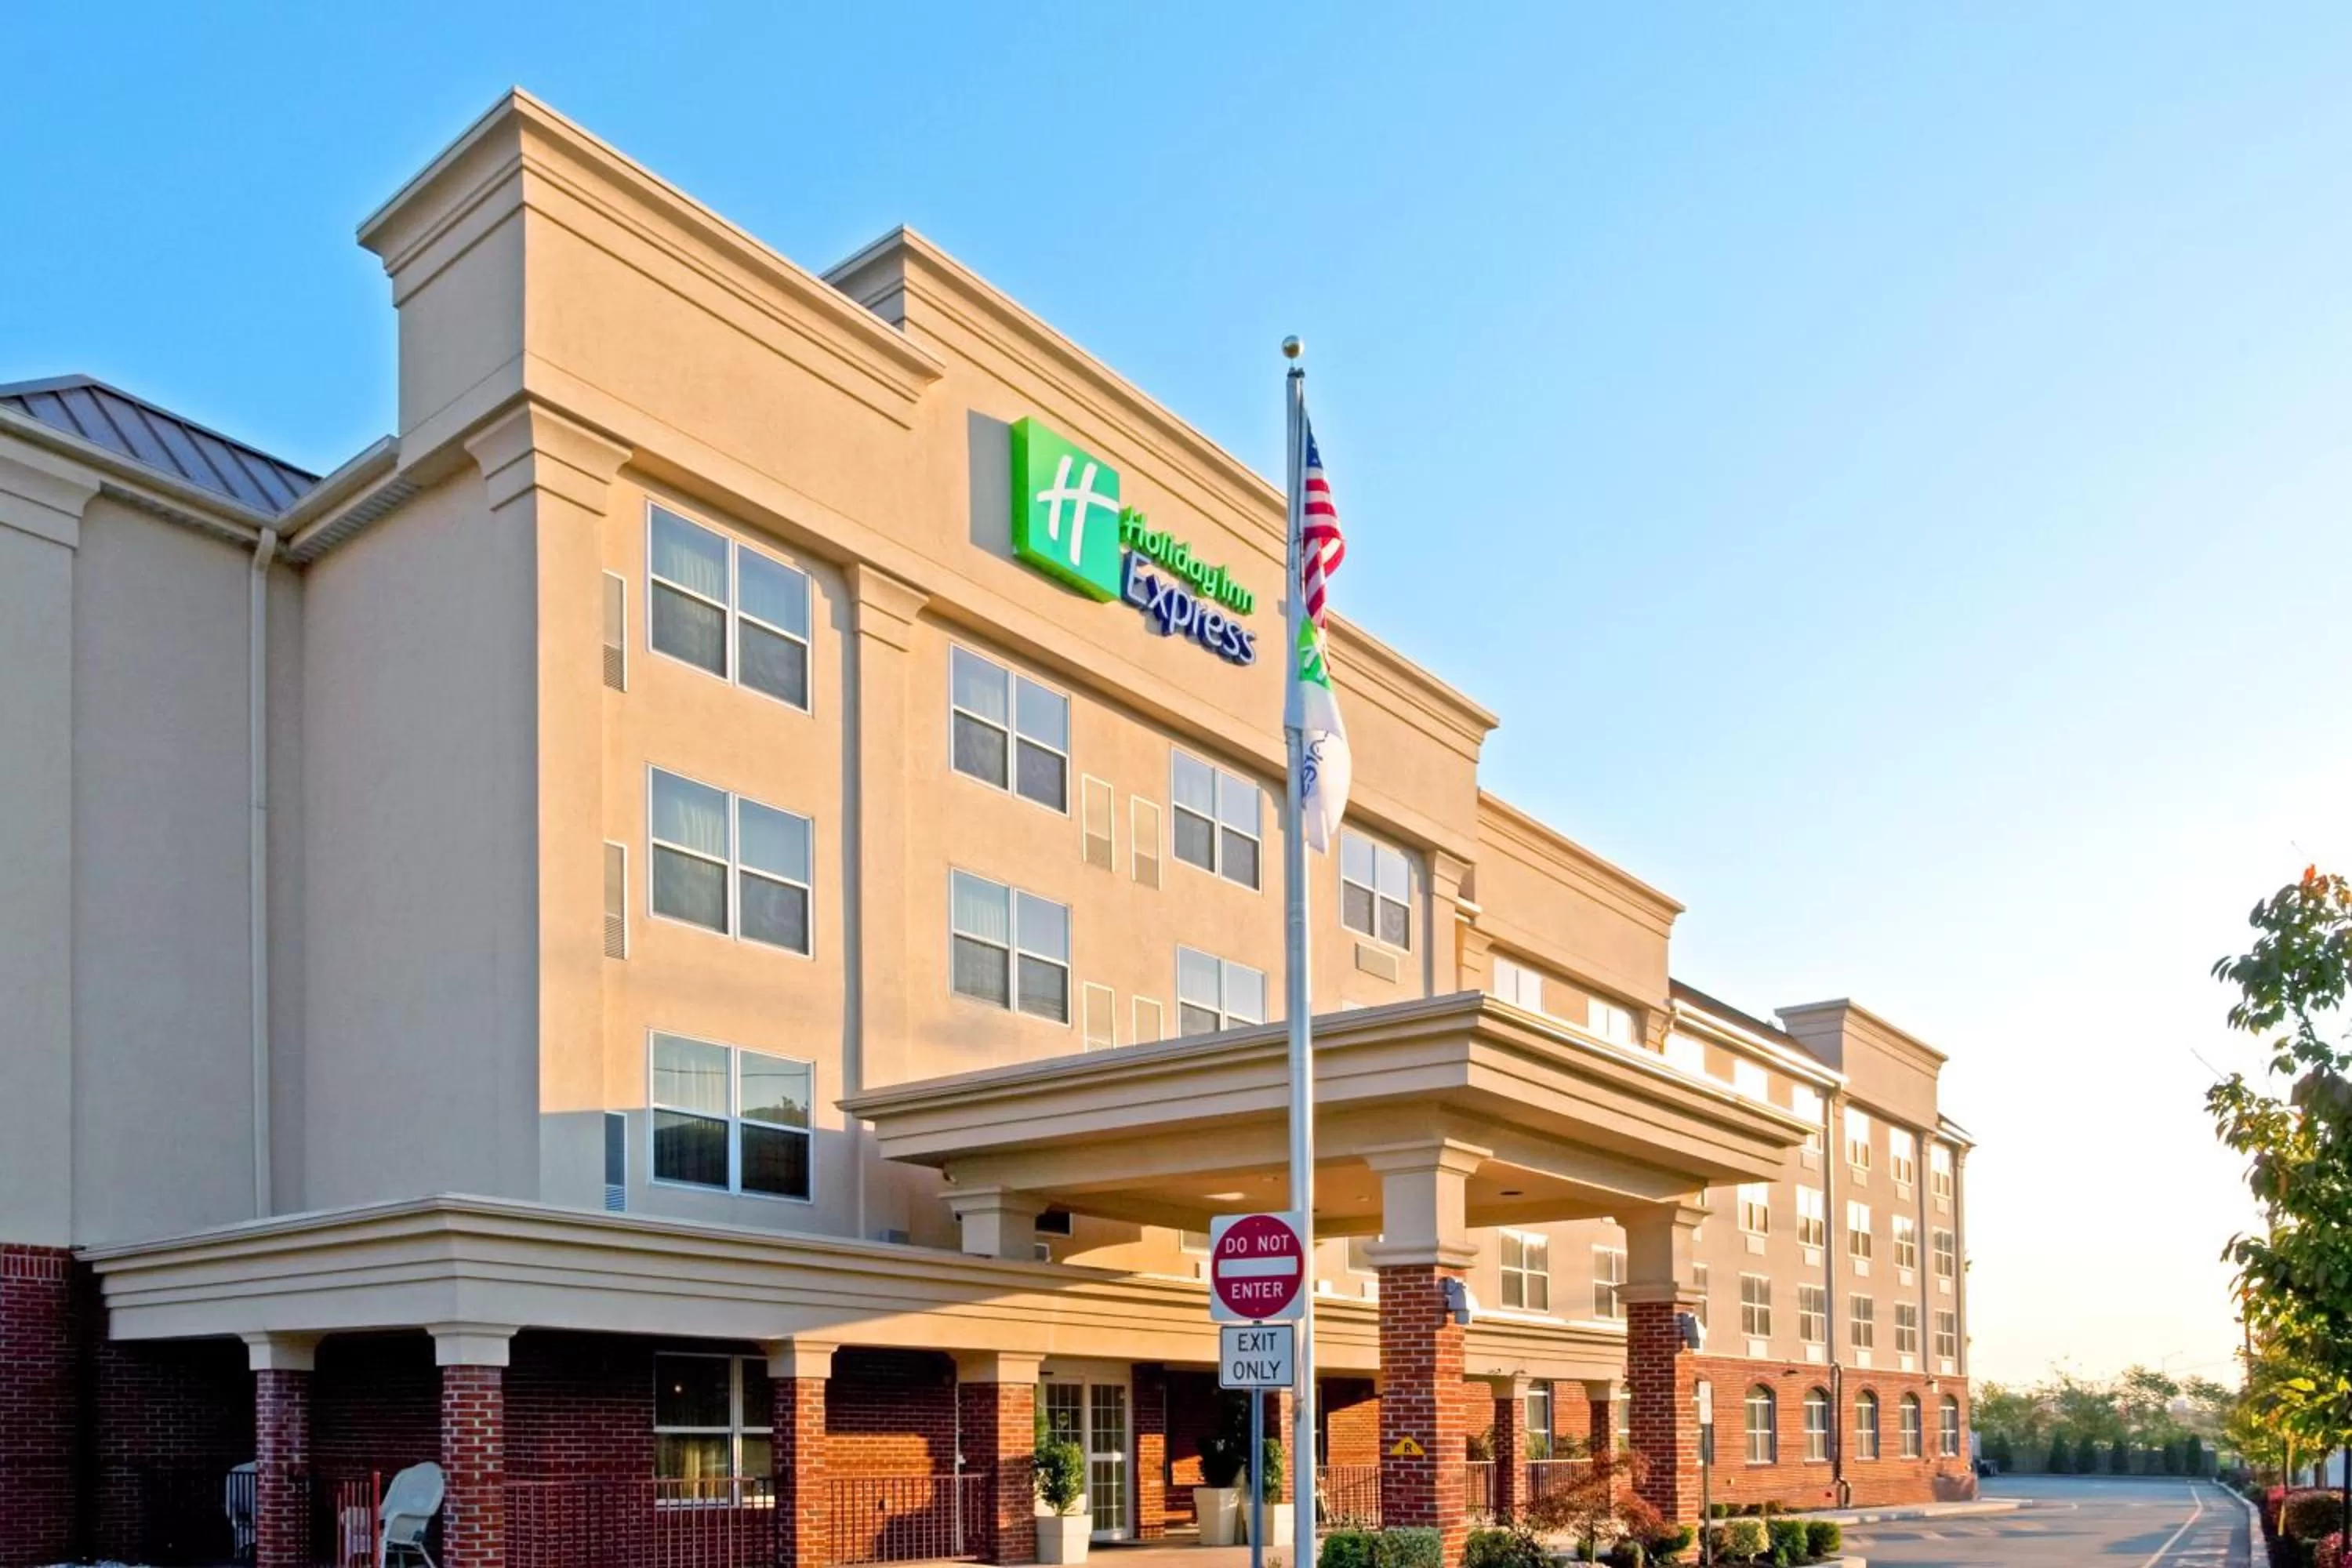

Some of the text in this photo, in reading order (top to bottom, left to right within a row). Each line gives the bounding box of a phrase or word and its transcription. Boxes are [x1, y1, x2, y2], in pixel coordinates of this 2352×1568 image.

[1122, 506, 1255, 615] Holiday Inn
[1123, 550, 1256, 664] Express
[1225, 1234, 1290, 1254] DO NOT
[1231, 1281, 1284, 1299] ENTER
[1237, 1332, 1277, 1352] EXIT
[1232, 1360, 1281, 1381] ONLY
[1404, 1442, 1412, 1453] R
